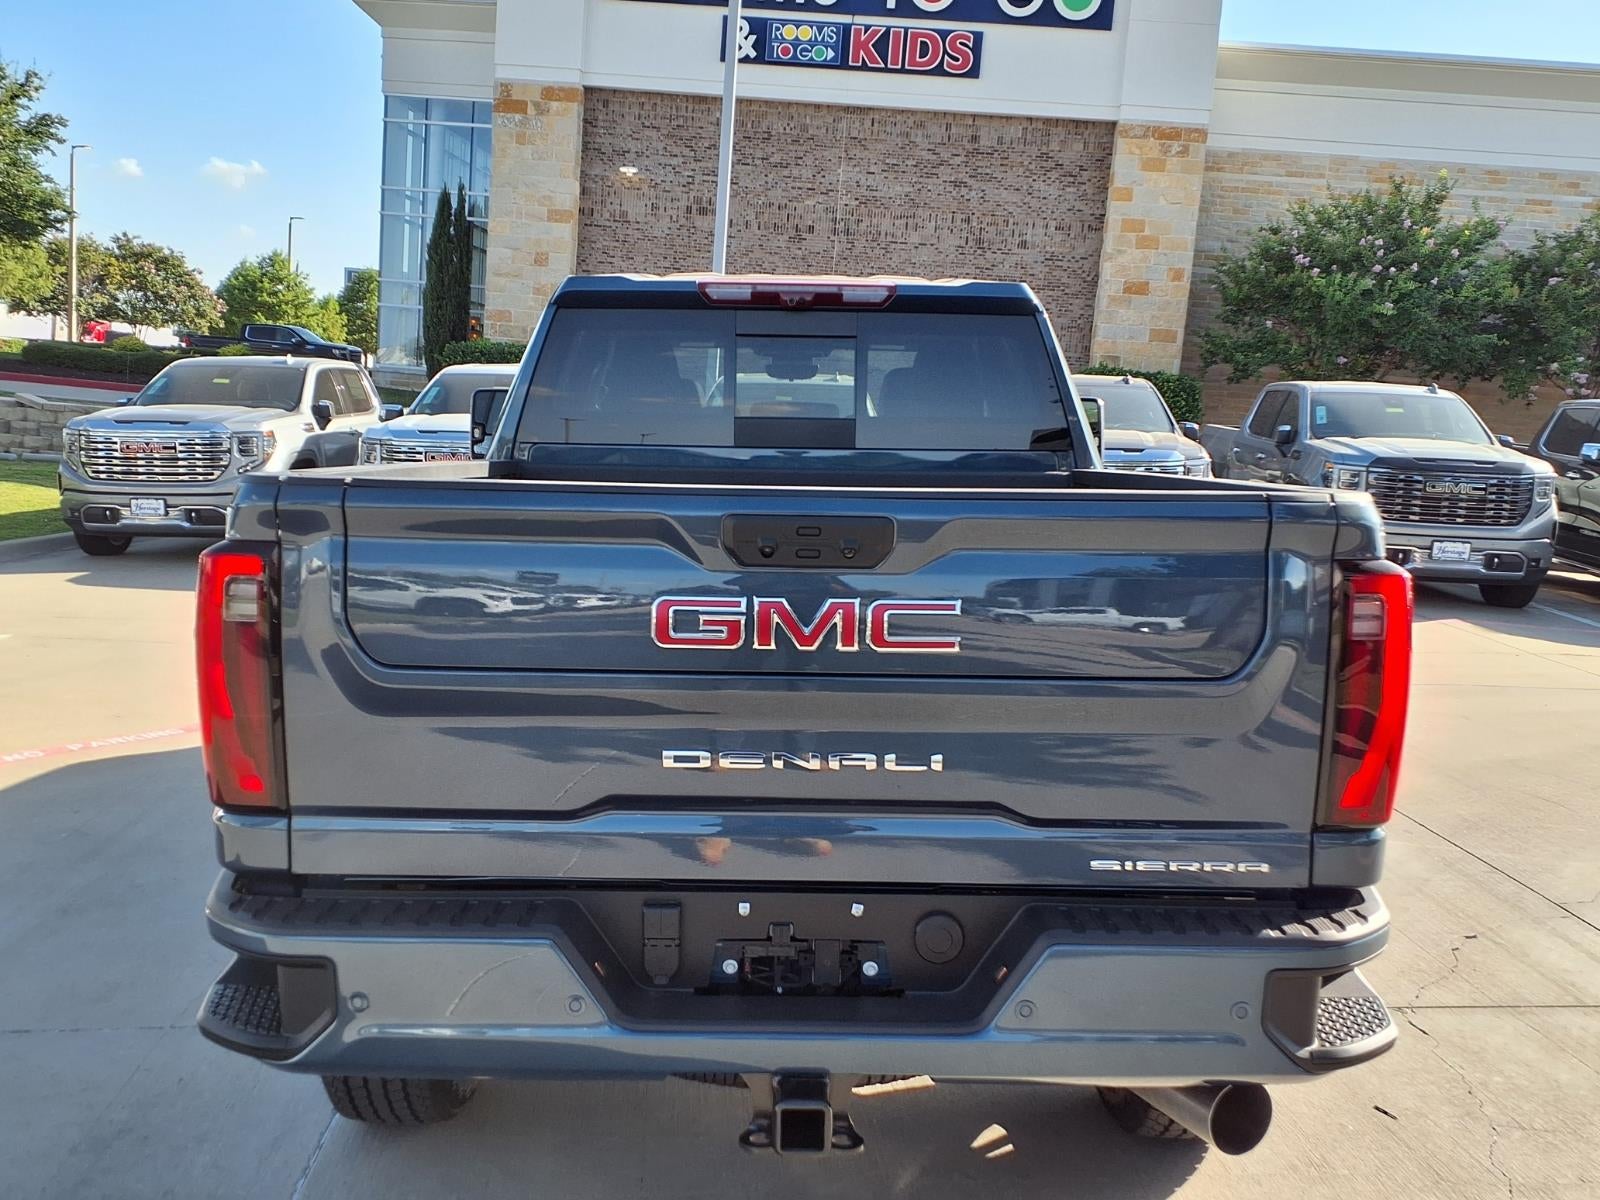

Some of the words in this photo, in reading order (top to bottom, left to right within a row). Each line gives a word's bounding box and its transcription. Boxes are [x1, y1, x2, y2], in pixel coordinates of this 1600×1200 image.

[771, 23, 836, 43] ROOMS
[771, 43, 794, 59] TO
[796, 44, 829, 61] GO
[848, 25, 974, 74] KIDS
[120, 441, 176, 453] GMC
[1425, 482, 1487, 495] GMC
[650, 596, 963, 652] GMC
[662, 750, 944, 772] DENALI
[1089, 859, 1271, 873] SIERRA
